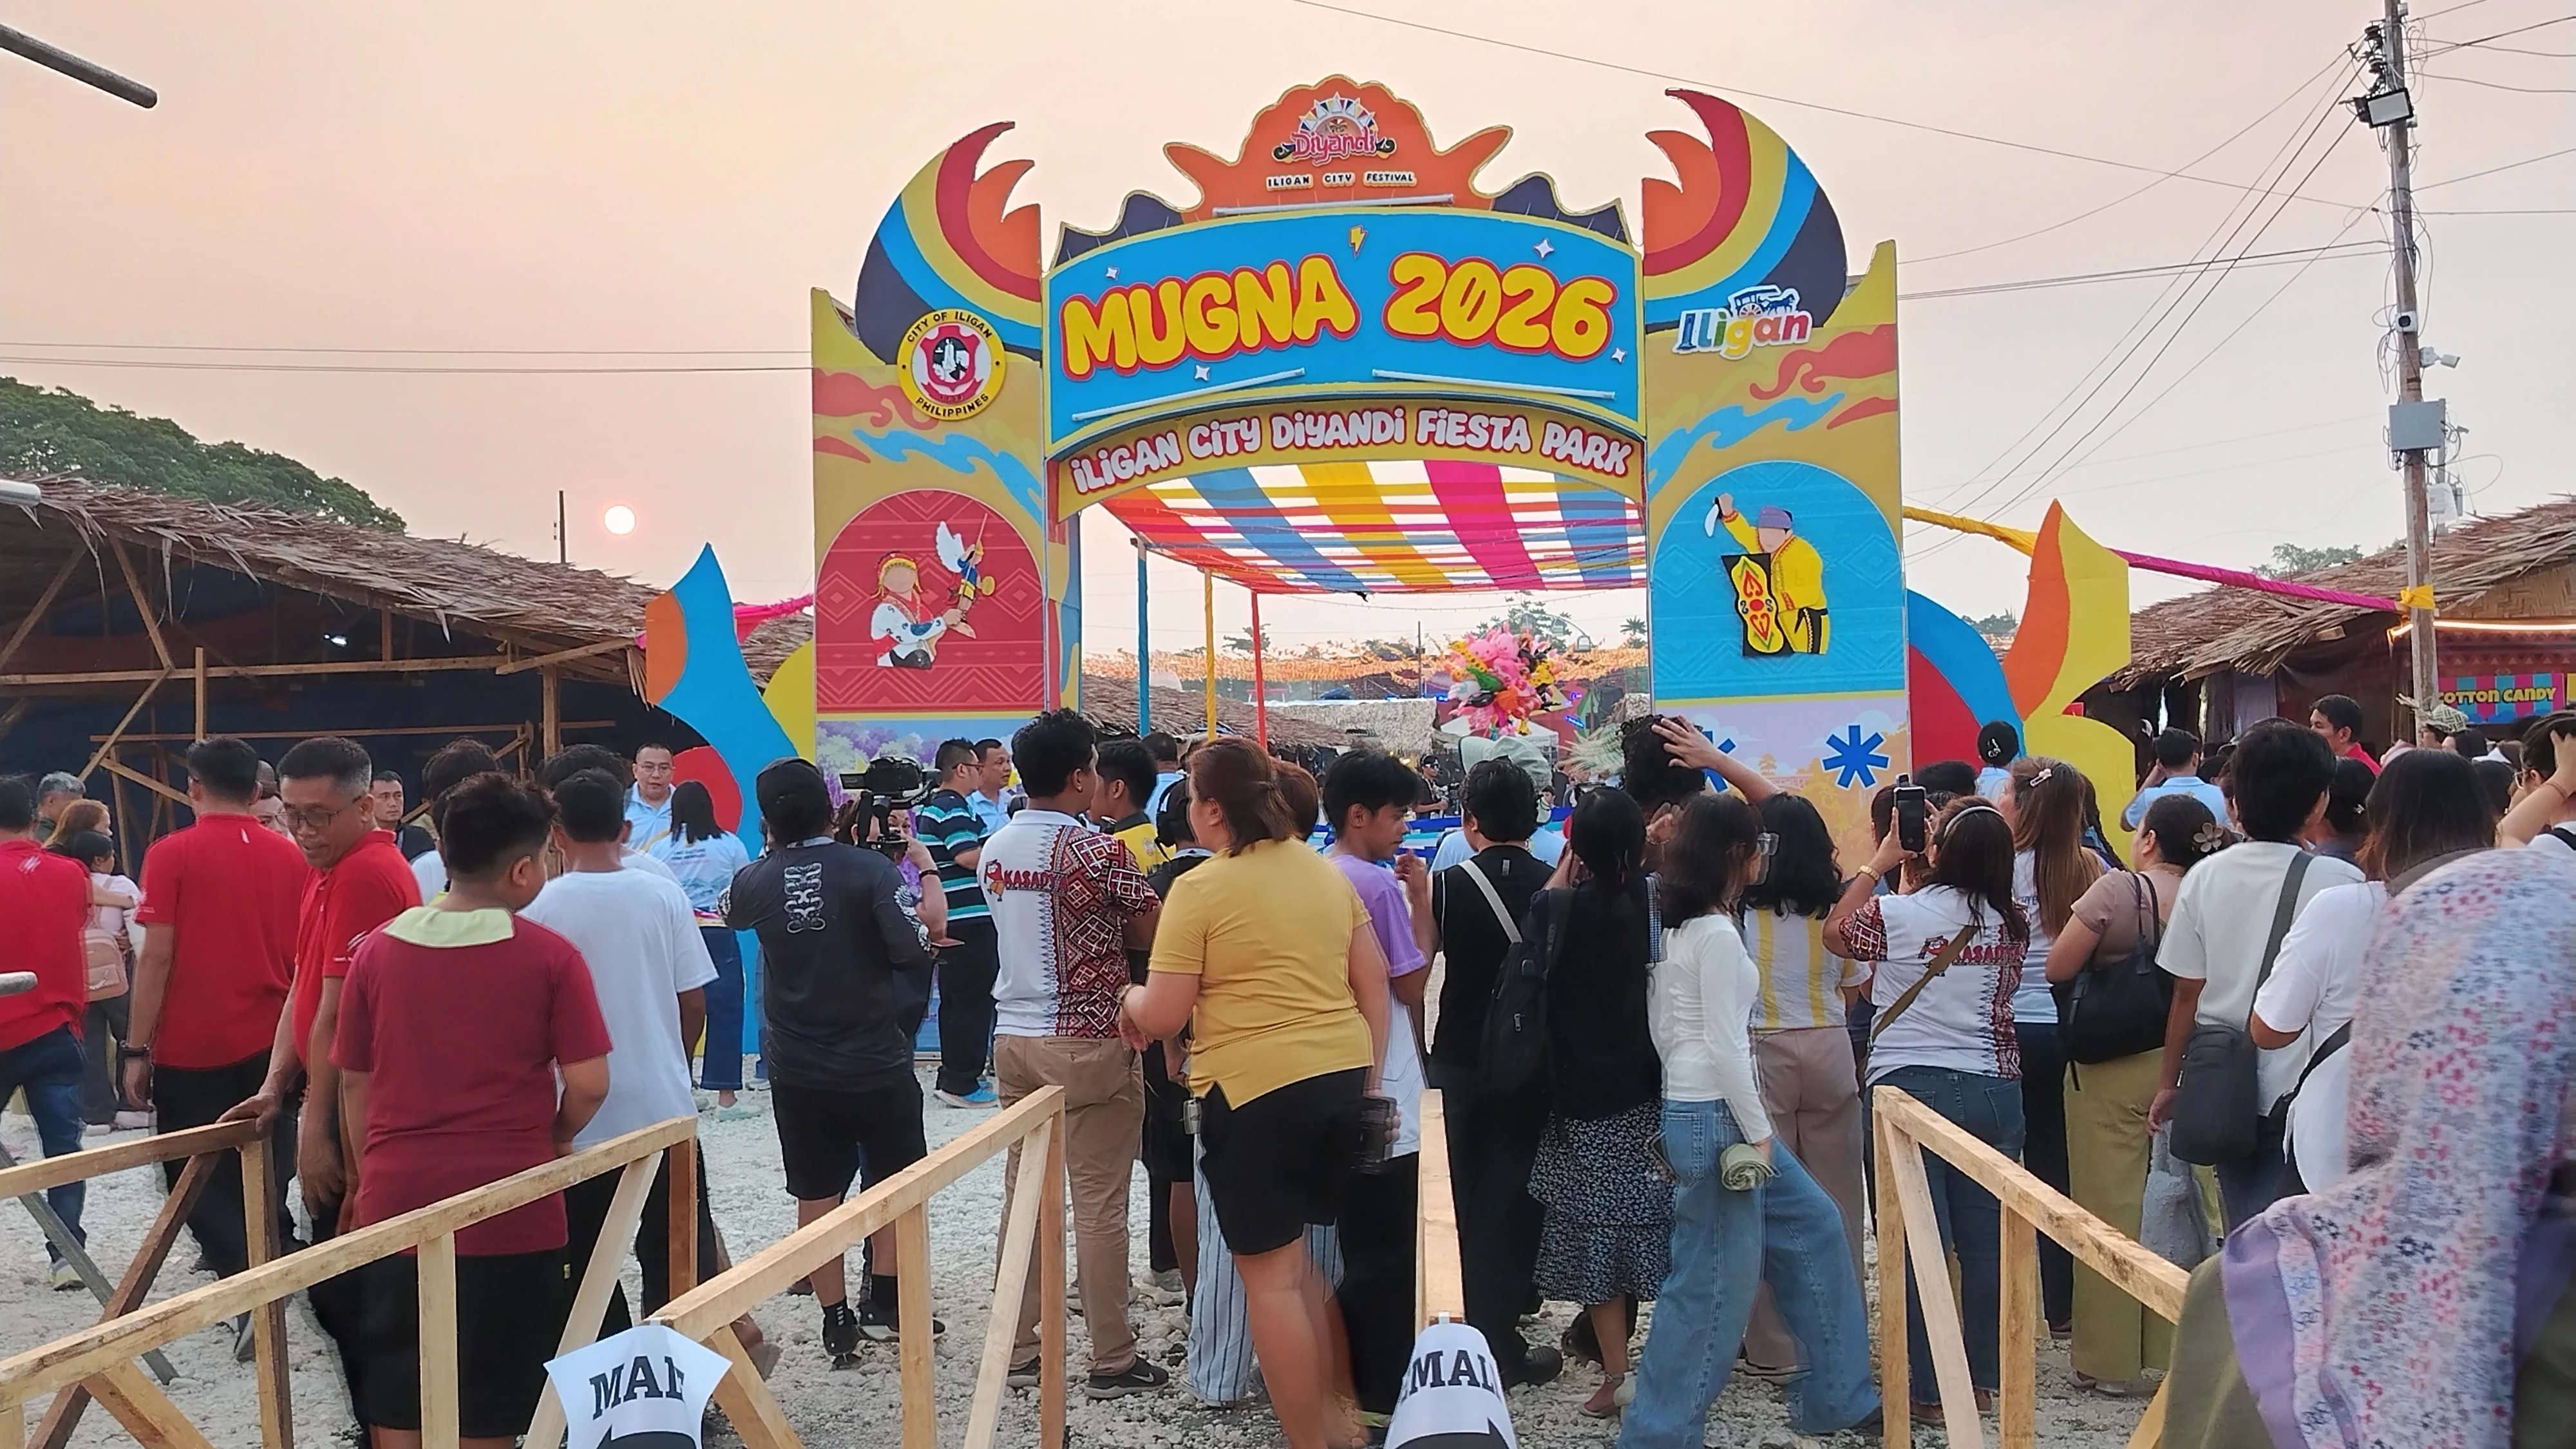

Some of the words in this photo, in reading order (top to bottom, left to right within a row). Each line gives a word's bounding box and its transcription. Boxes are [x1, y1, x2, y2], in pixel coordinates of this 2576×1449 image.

[1291, 127, 1376, 160] Diyandi
[1325, 173, 1352, 182] CITY
[1366, 173, 1413, 182] FESTIVAL
[907, 319, 928, 342] CITY
[934, 312, 947, 321] OF
[954, 311, 992, 339] ILIGAN
[1060, 252, 1360, 380] MUGNA
[1381, 251, 1616, 362] 2026
[1676, 311, 1809, 355] Iligan
[916, 393, 989, 417] PHILIPPINES
[1542, 422, 1632, 475] PARK
[1401, 1350, 1502, 1403] MAL
